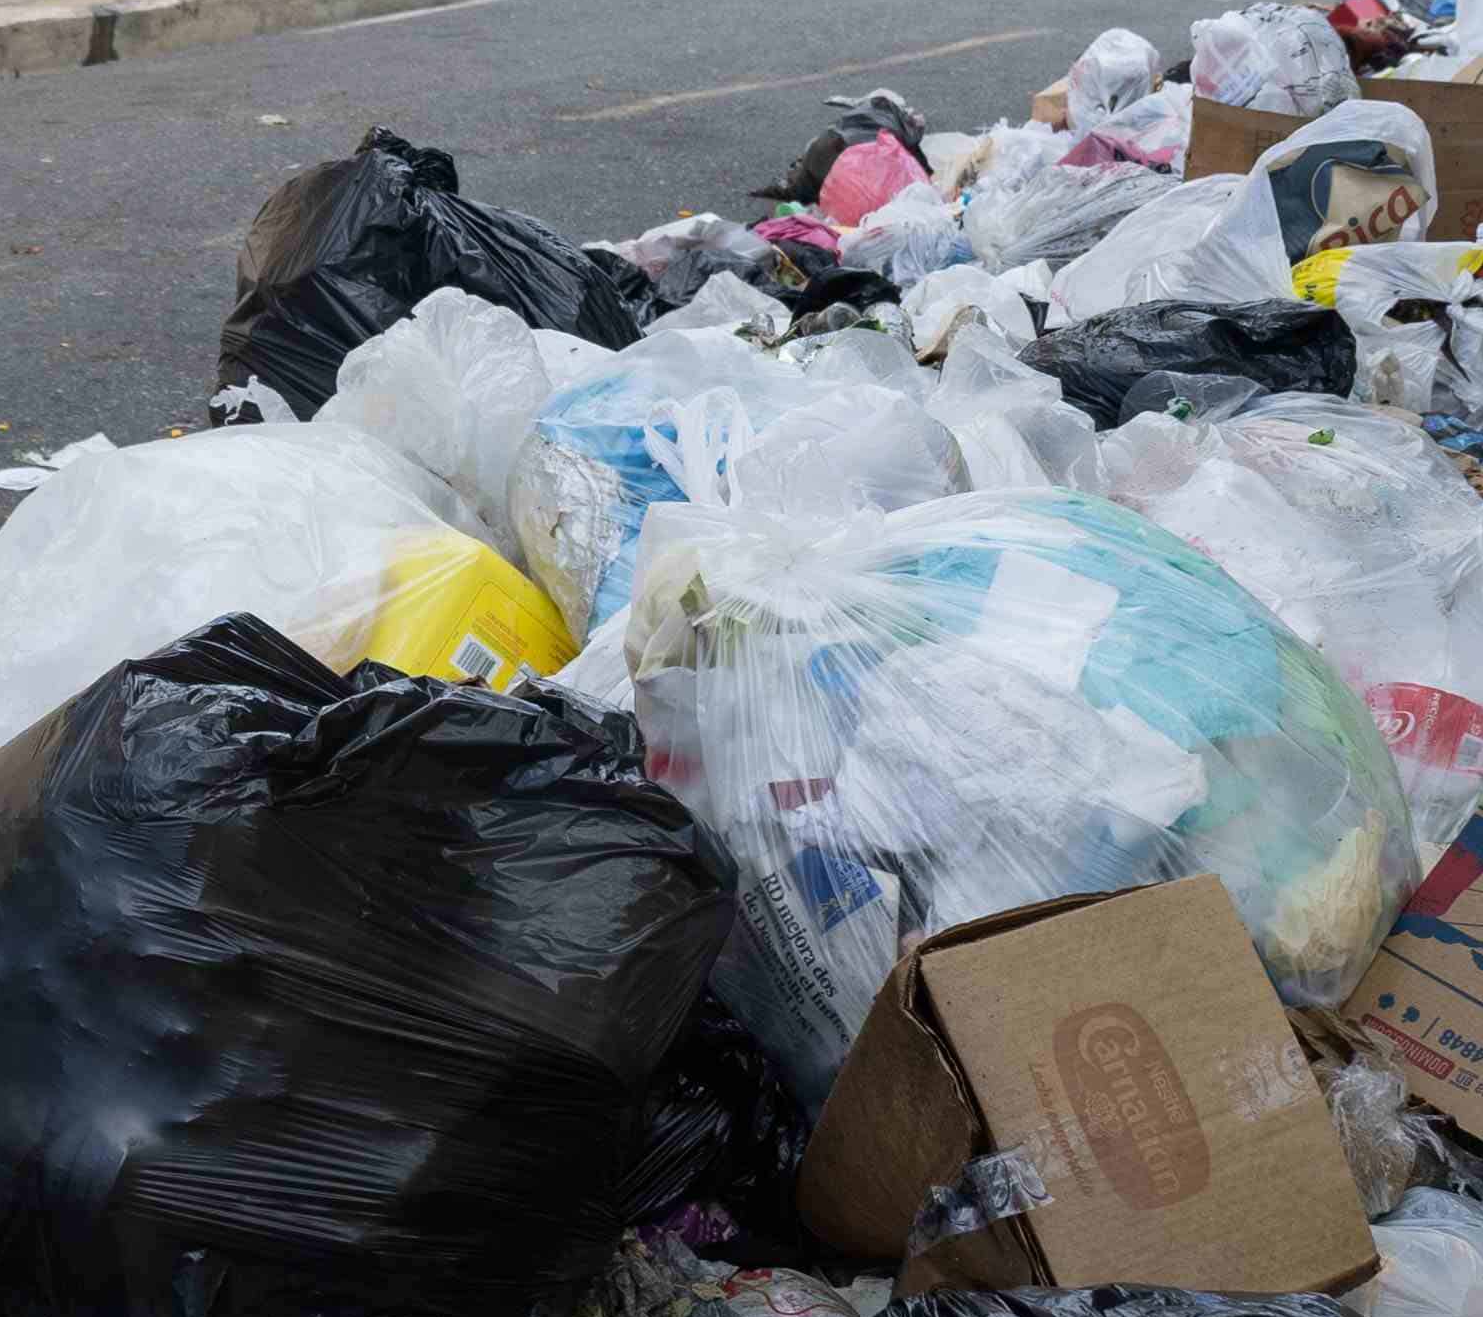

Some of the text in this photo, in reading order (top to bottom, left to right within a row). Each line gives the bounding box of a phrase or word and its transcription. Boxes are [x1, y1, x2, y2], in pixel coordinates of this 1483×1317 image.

[763, 872, 838, 998] RD mejora dos
[1077, 1015, 1181, 1196] Carnation
